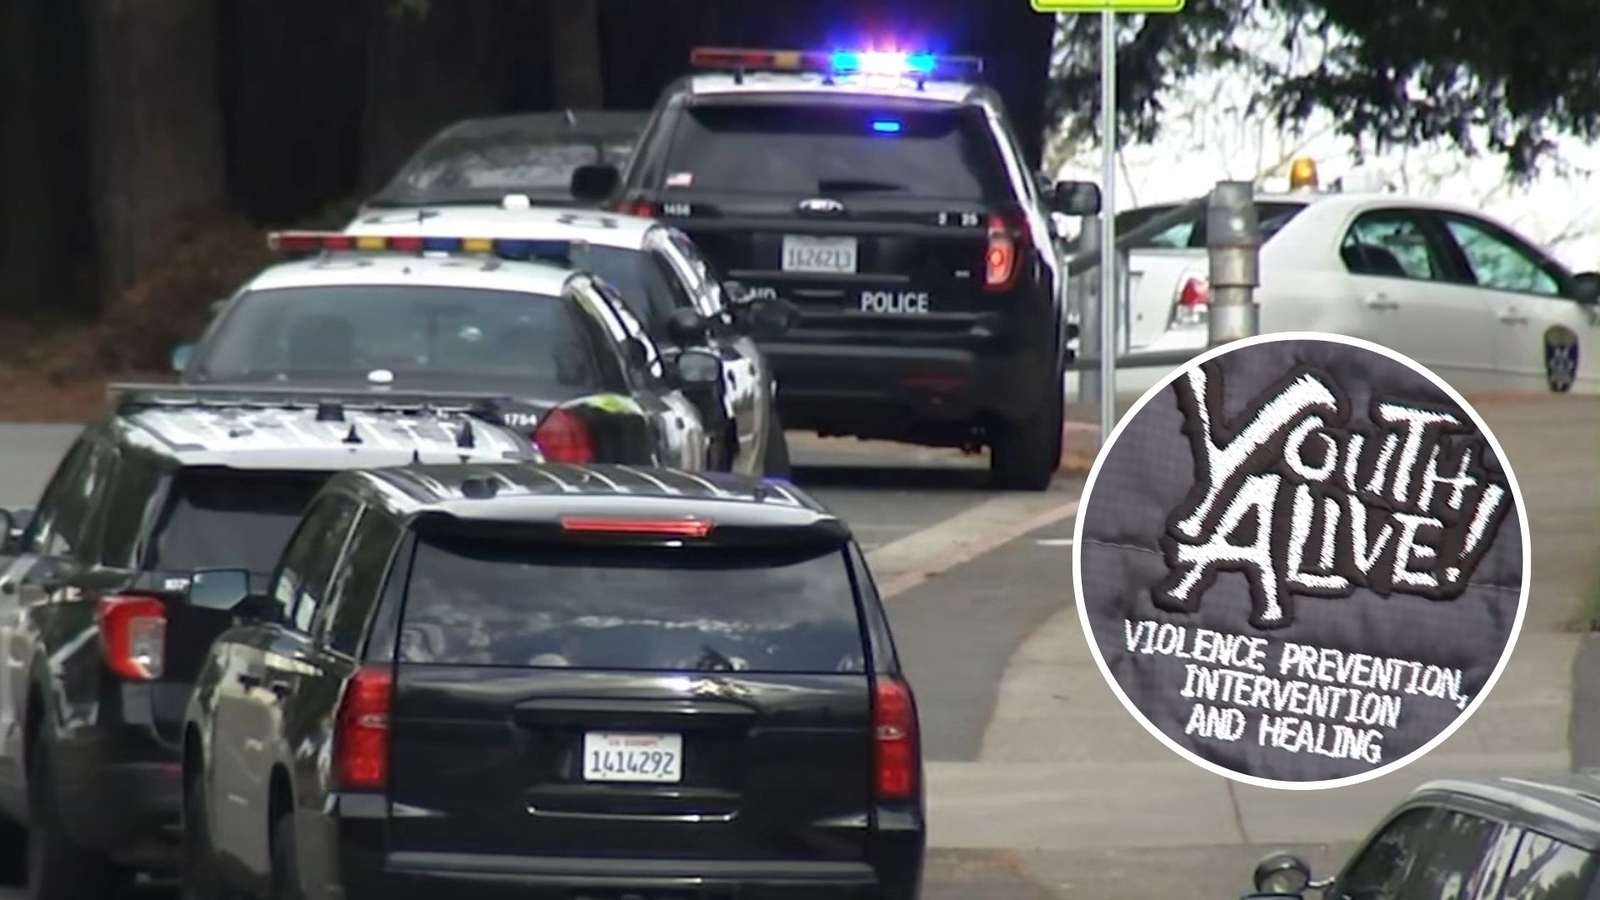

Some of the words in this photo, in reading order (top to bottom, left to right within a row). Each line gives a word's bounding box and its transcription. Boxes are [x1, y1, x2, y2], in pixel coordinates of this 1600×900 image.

[861, 291, 929, 313] POLICE
[1178, 367, 1477, 537] YOUTH
[1167, 473, 1504, 620] ALIVE!
[1124, 618, 1268, 672] VIOLENCE
[1279, 642, 1469, 710] PREVENTION,
[1180, 664, 1402, 729] INTERVENTION
[591, 750, 675, 775] 1414292
[1185, 703, 1247, 741] AND
[1258, 714, 1384, 764] HEALING
